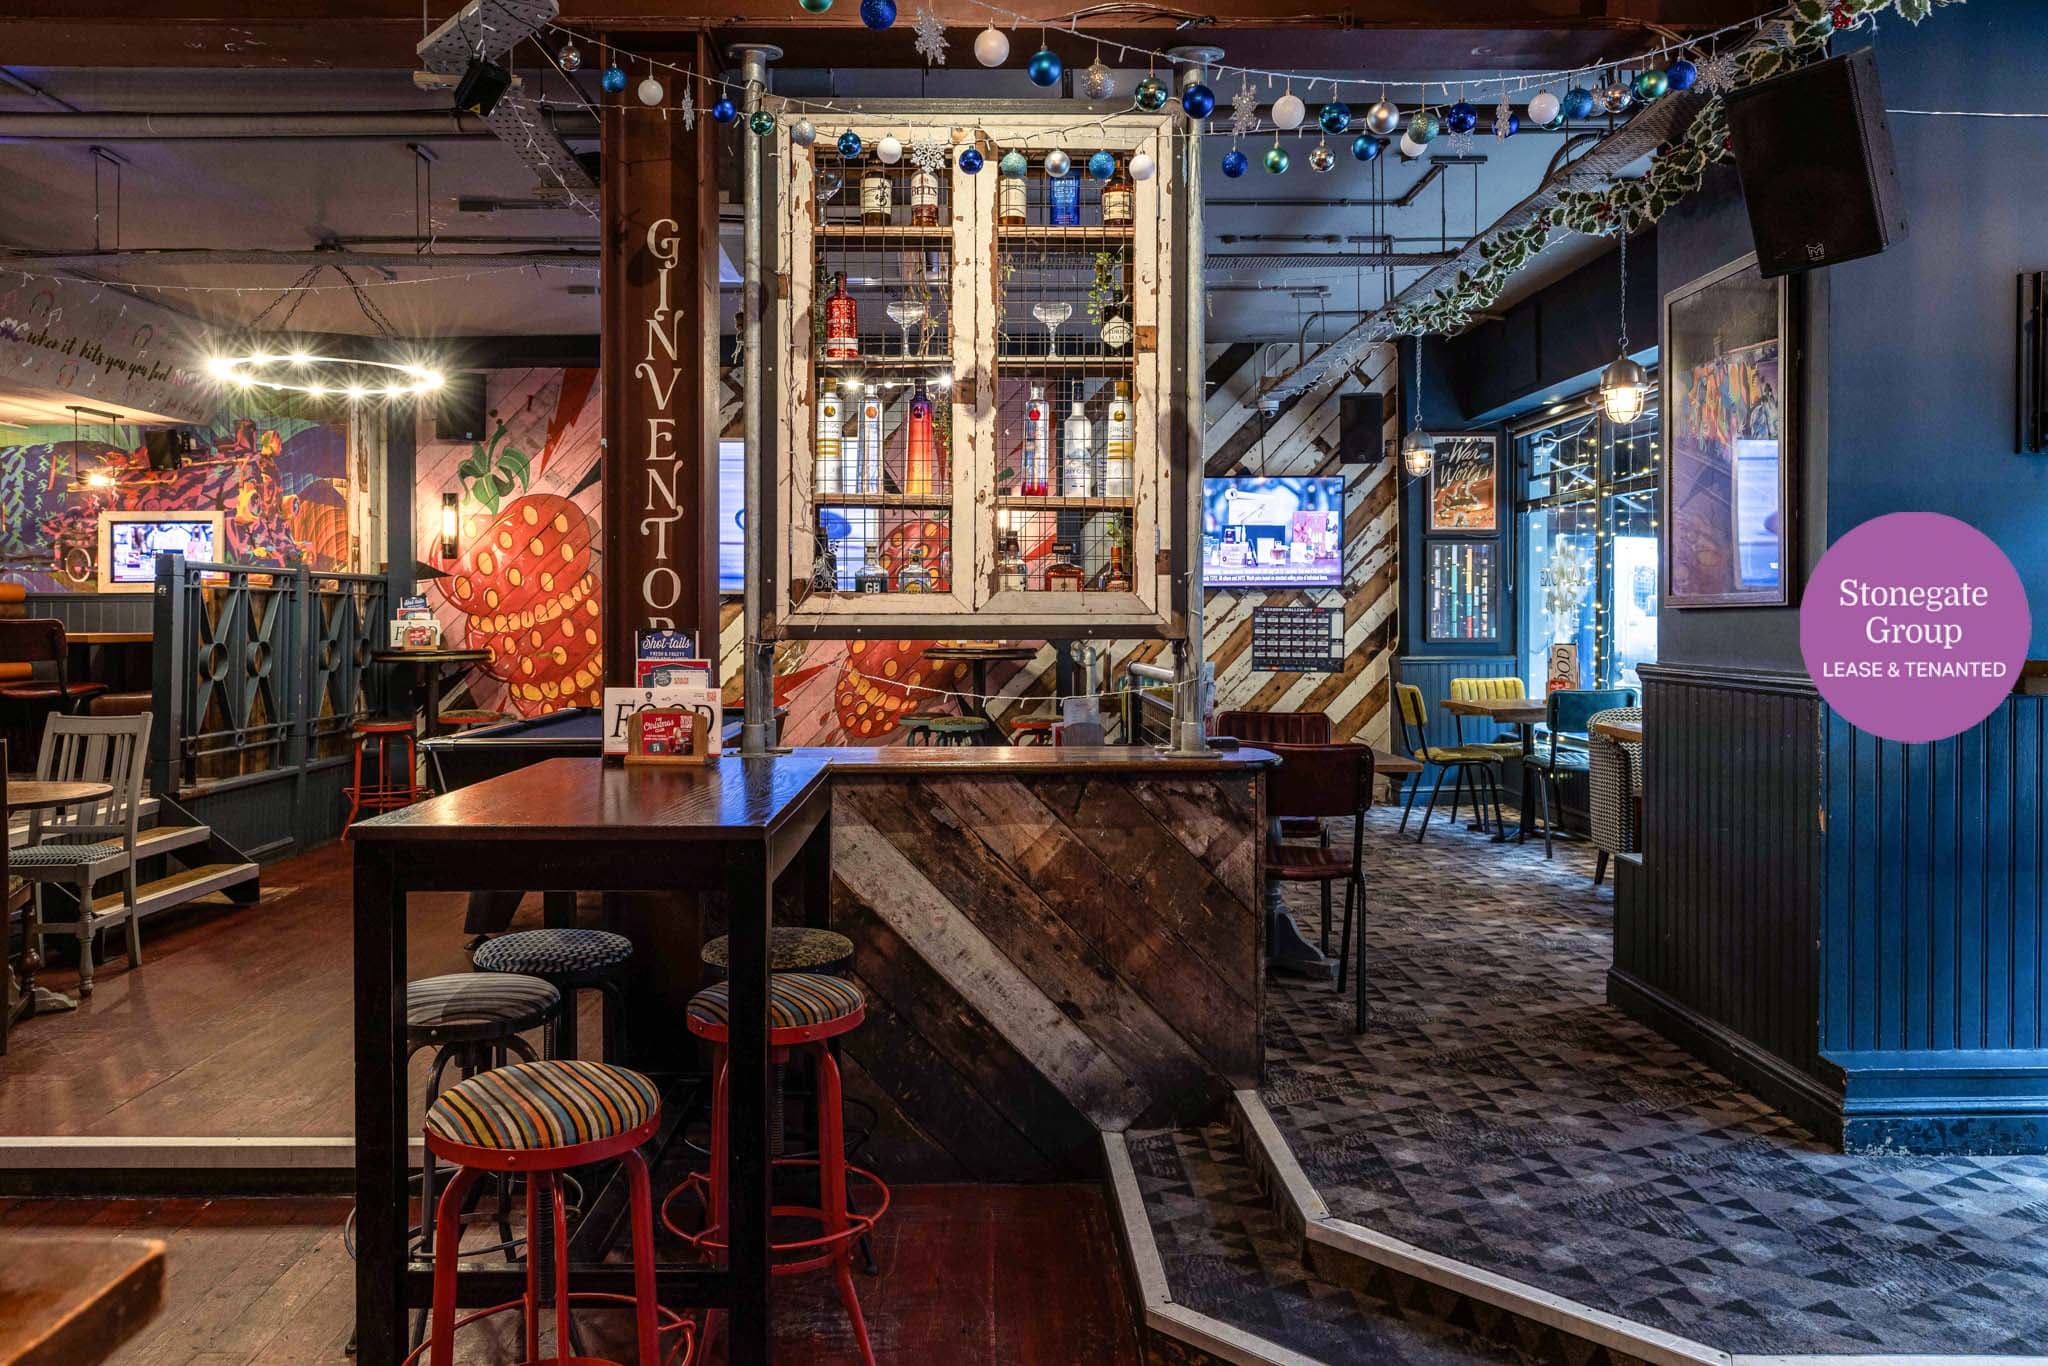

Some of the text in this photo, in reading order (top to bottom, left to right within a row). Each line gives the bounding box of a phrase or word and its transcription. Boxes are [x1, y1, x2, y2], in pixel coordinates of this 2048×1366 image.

[61, 337, 77, 355] it
[80, 340, 104, 366] hits
[1449, 440, 1481, 465] War
[865, 582, 881, 594] GB
[642, 635, 691, 650] Shot-tails
